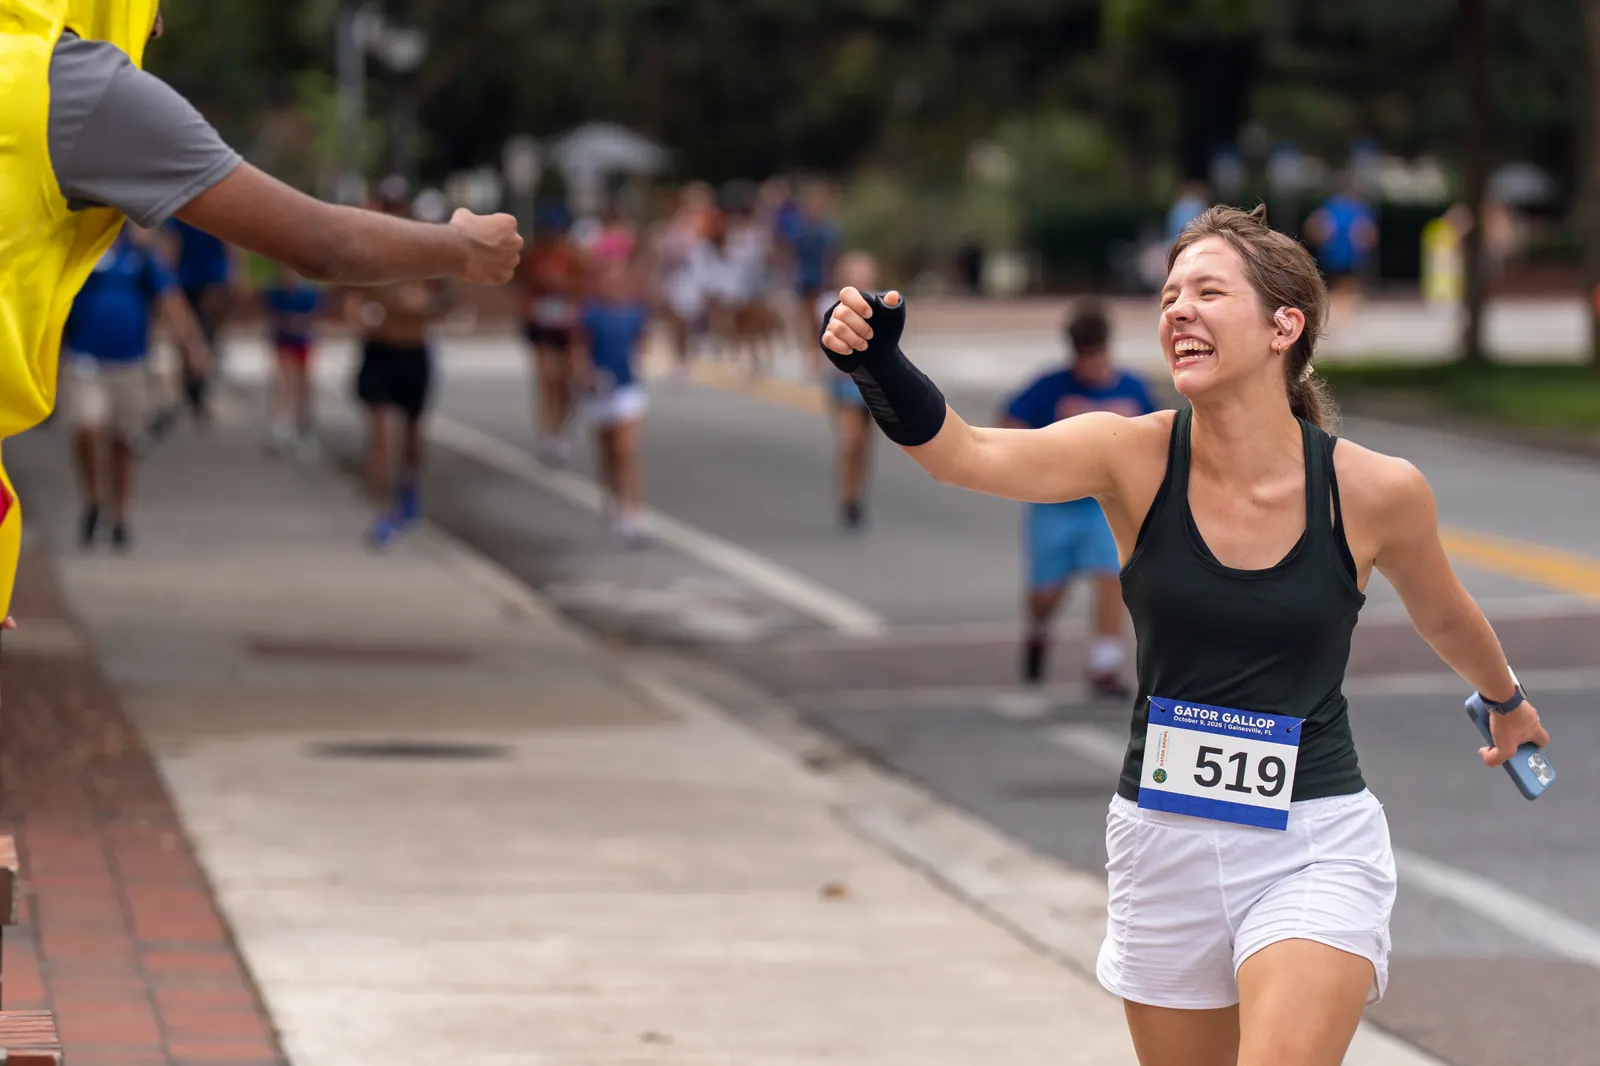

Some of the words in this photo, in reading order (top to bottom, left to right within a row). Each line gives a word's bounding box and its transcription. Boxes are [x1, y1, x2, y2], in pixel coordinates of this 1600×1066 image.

[1174, 705, 1218, 721] GATOR
[1222, 713, 1275, 729] GALLOP
[1174, 716, 1198, 724] October
[1228, 724, 1262, 735] Gainesville,
[1193, 745, 1286, 797] 519
